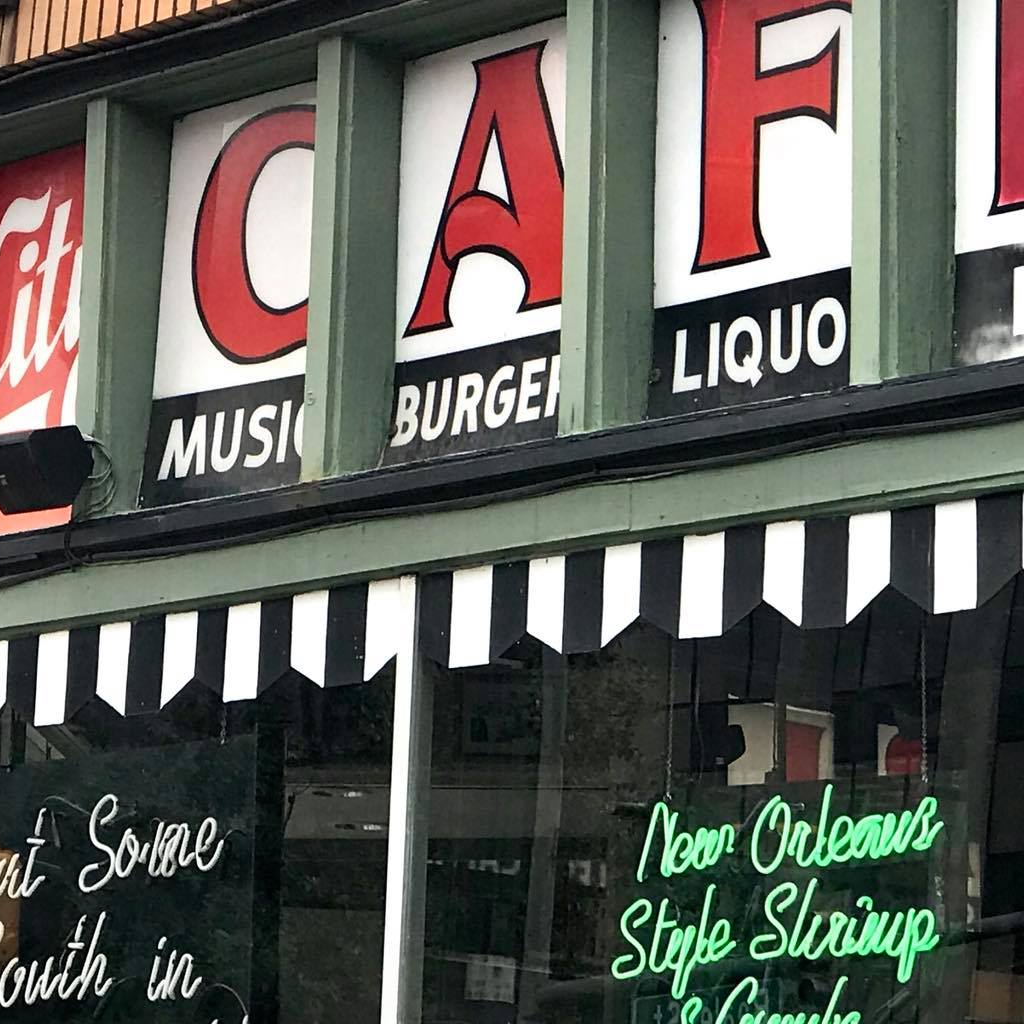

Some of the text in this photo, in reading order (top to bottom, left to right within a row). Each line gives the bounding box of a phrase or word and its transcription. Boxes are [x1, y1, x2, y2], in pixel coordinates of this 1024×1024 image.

[671, 296, 847, 394] LIQUO
[78, 793, 225, 894] Some
[637, 773, 944, 883] New Orleans
[147, 935, 203, 1002] in
[611, 877, 940, 999] Style Shrimp
